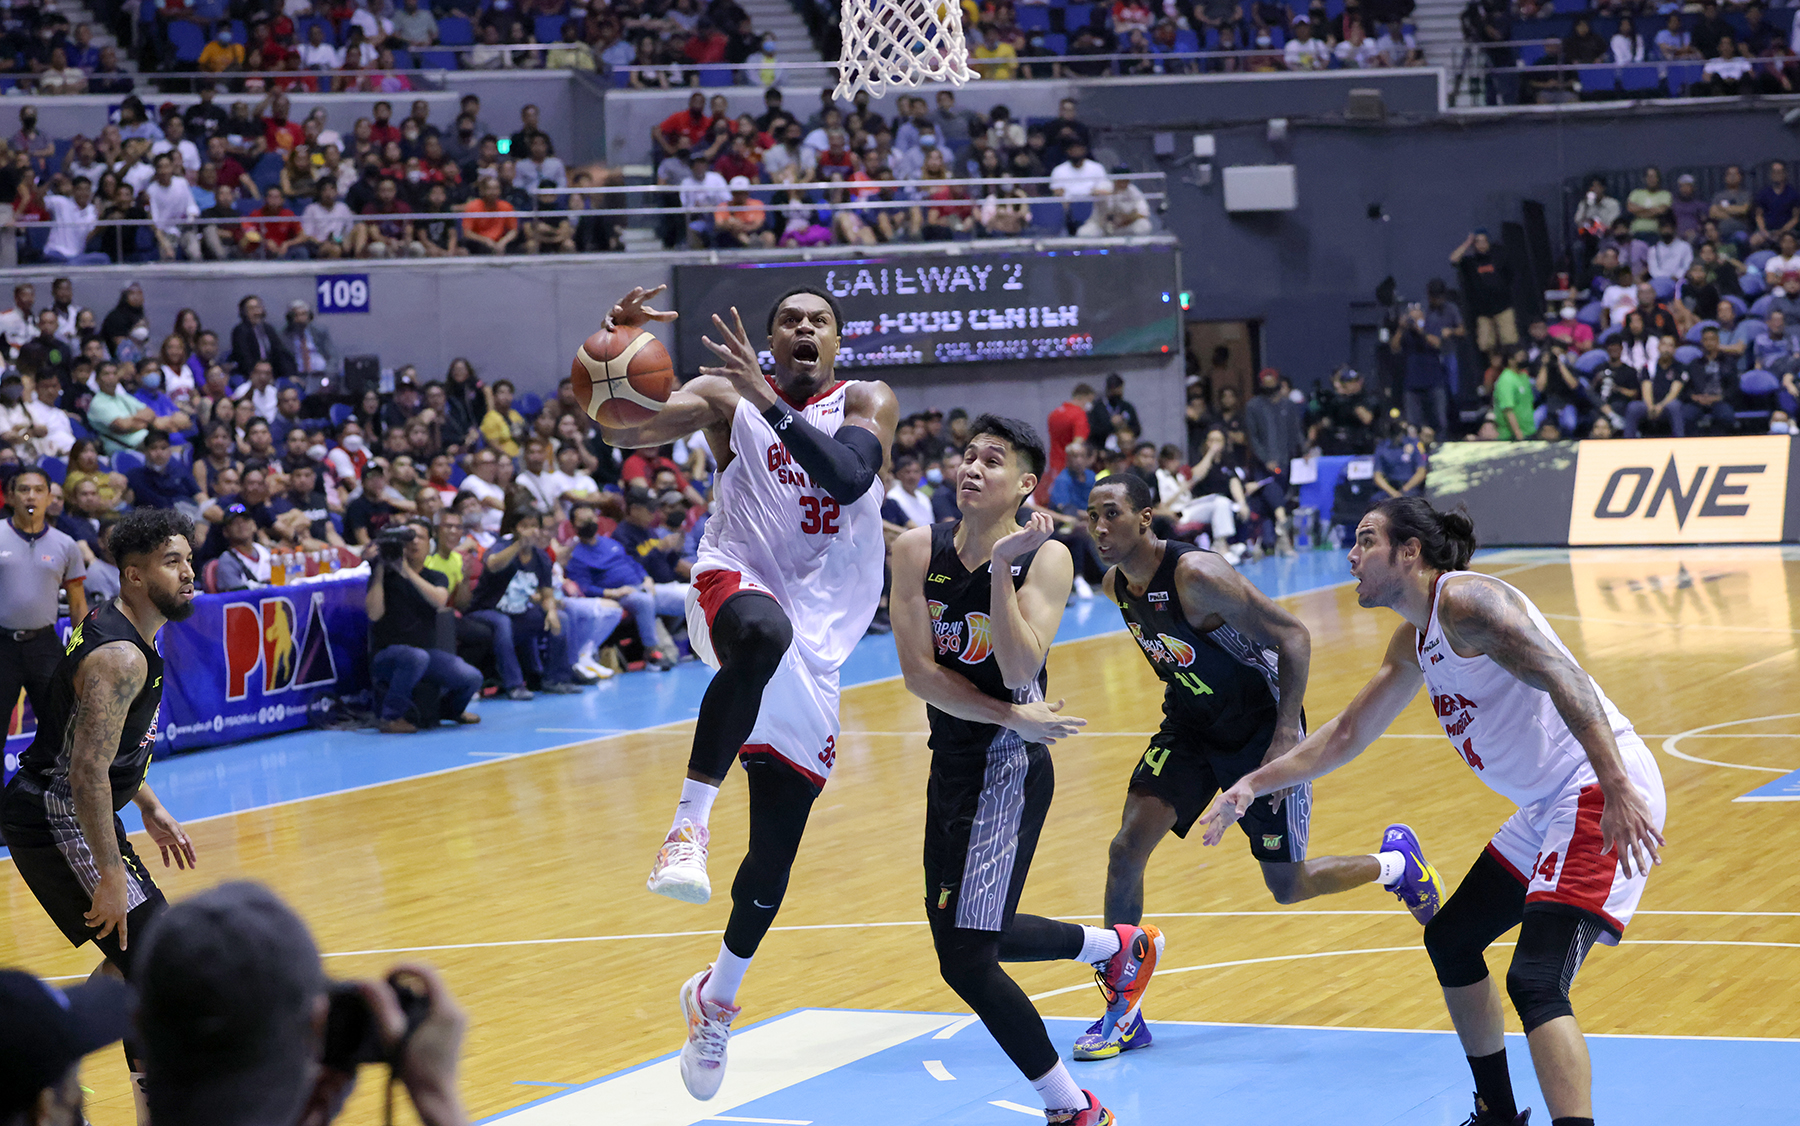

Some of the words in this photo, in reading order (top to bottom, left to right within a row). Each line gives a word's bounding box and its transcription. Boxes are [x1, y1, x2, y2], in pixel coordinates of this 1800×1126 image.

[1003, 264, 1023, 290] 2
[318, 280, 367, 307] 109
[778, 469, 805, 487] SAN
[1594, 450, 1767, 534] ONE
[799, 496, 840, 534] 32
[223, 592, 338, 702] PBA
[1139, 746, 1172, 777] 4
[1263, 835, 1283, 847] TNT
[1123, 962, 1137, 977] 13
